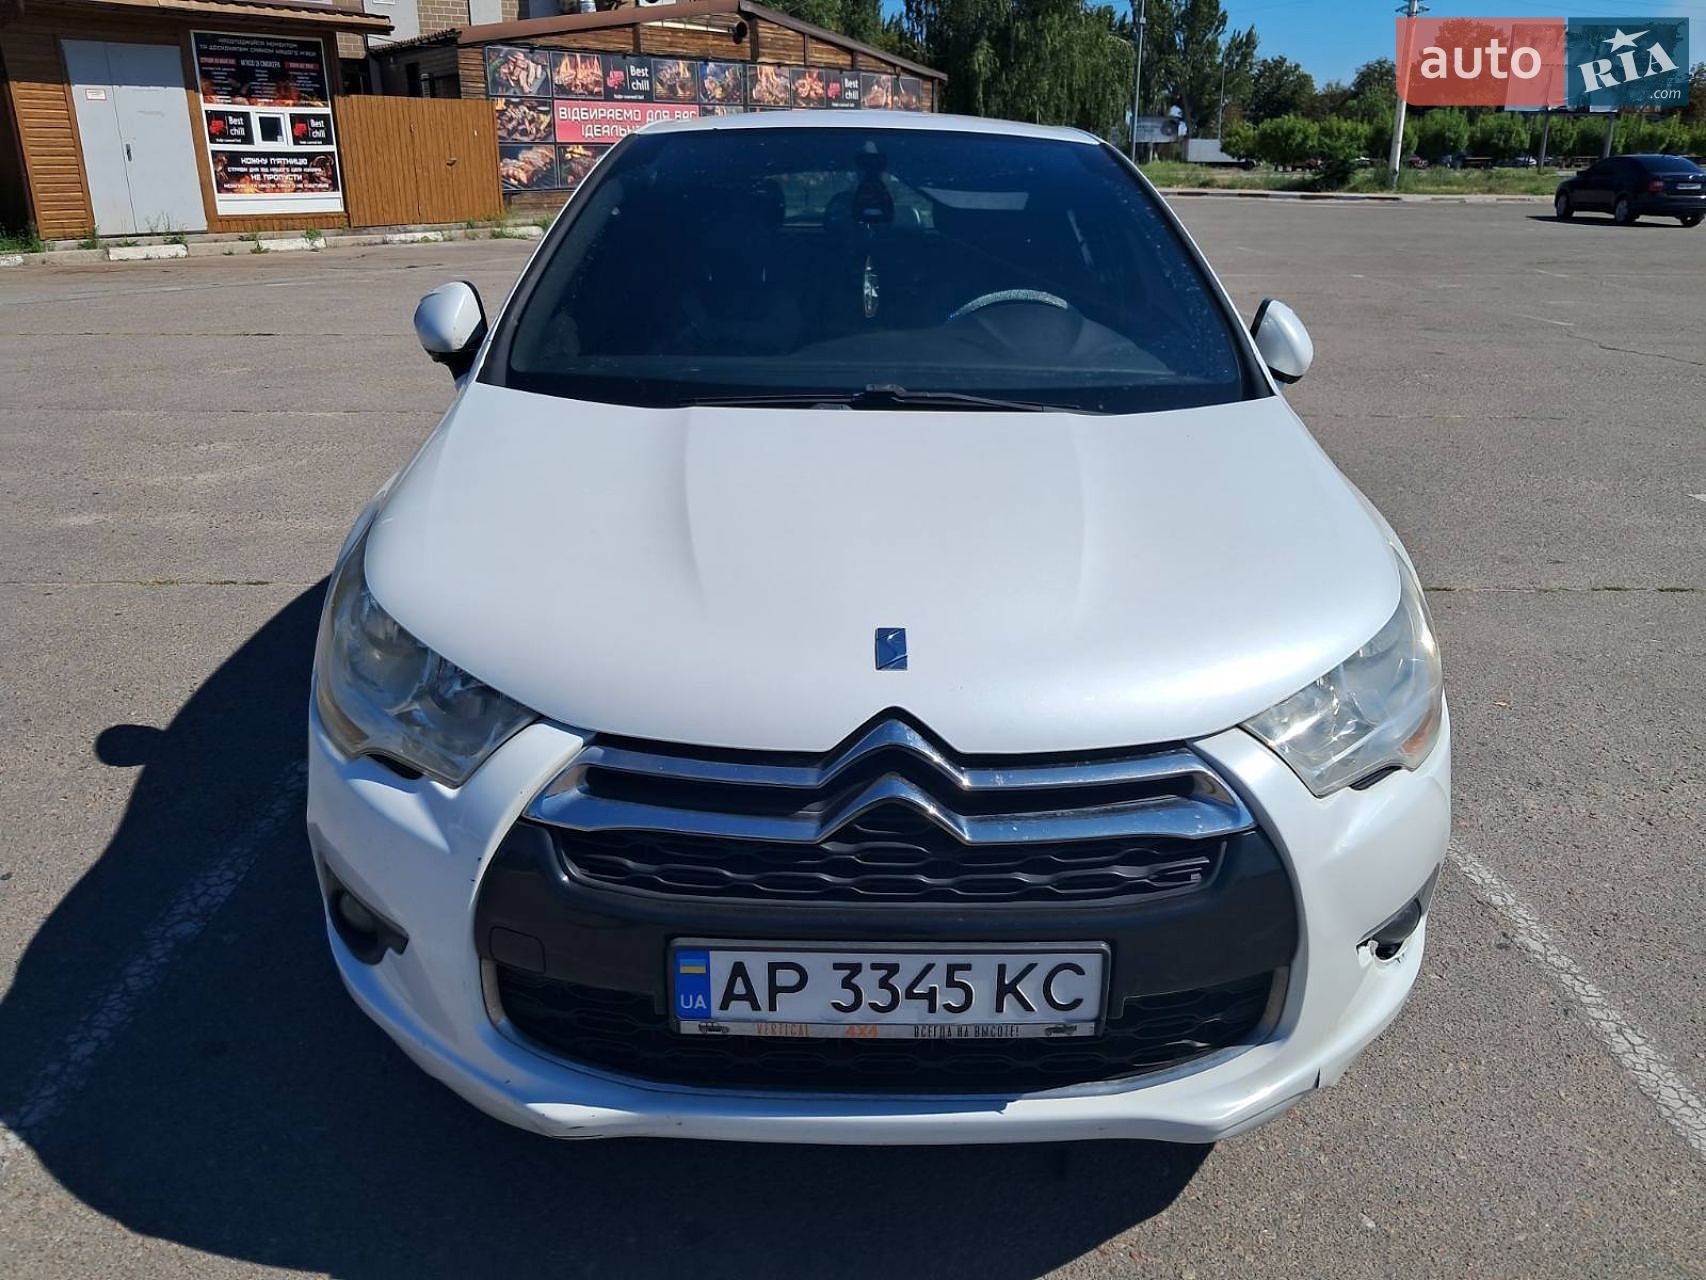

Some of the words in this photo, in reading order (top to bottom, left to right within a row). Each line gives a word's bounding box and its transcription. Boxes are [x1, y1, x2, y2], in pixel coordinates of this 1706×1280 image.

[630, 65, 649, 77] Best
[631, 80, 650, 91] chill
[844, 78, 859, 88] Best
[845, 90, 859, 100] chill
[558, 107, 641, 121] ВІДБИРАЄМО
[228, 115, 244, 126] Best
[310, 118, 325, 128] Best
[229, 127, 245, 136] chill
[311, 129, 326, 138] chill
[719, 960, 809, 1013] AP
[831, 961, 975, 1014] 3345
[995, 961, 1086, 1013] KC
[680, 994, 707, 1010] UA
